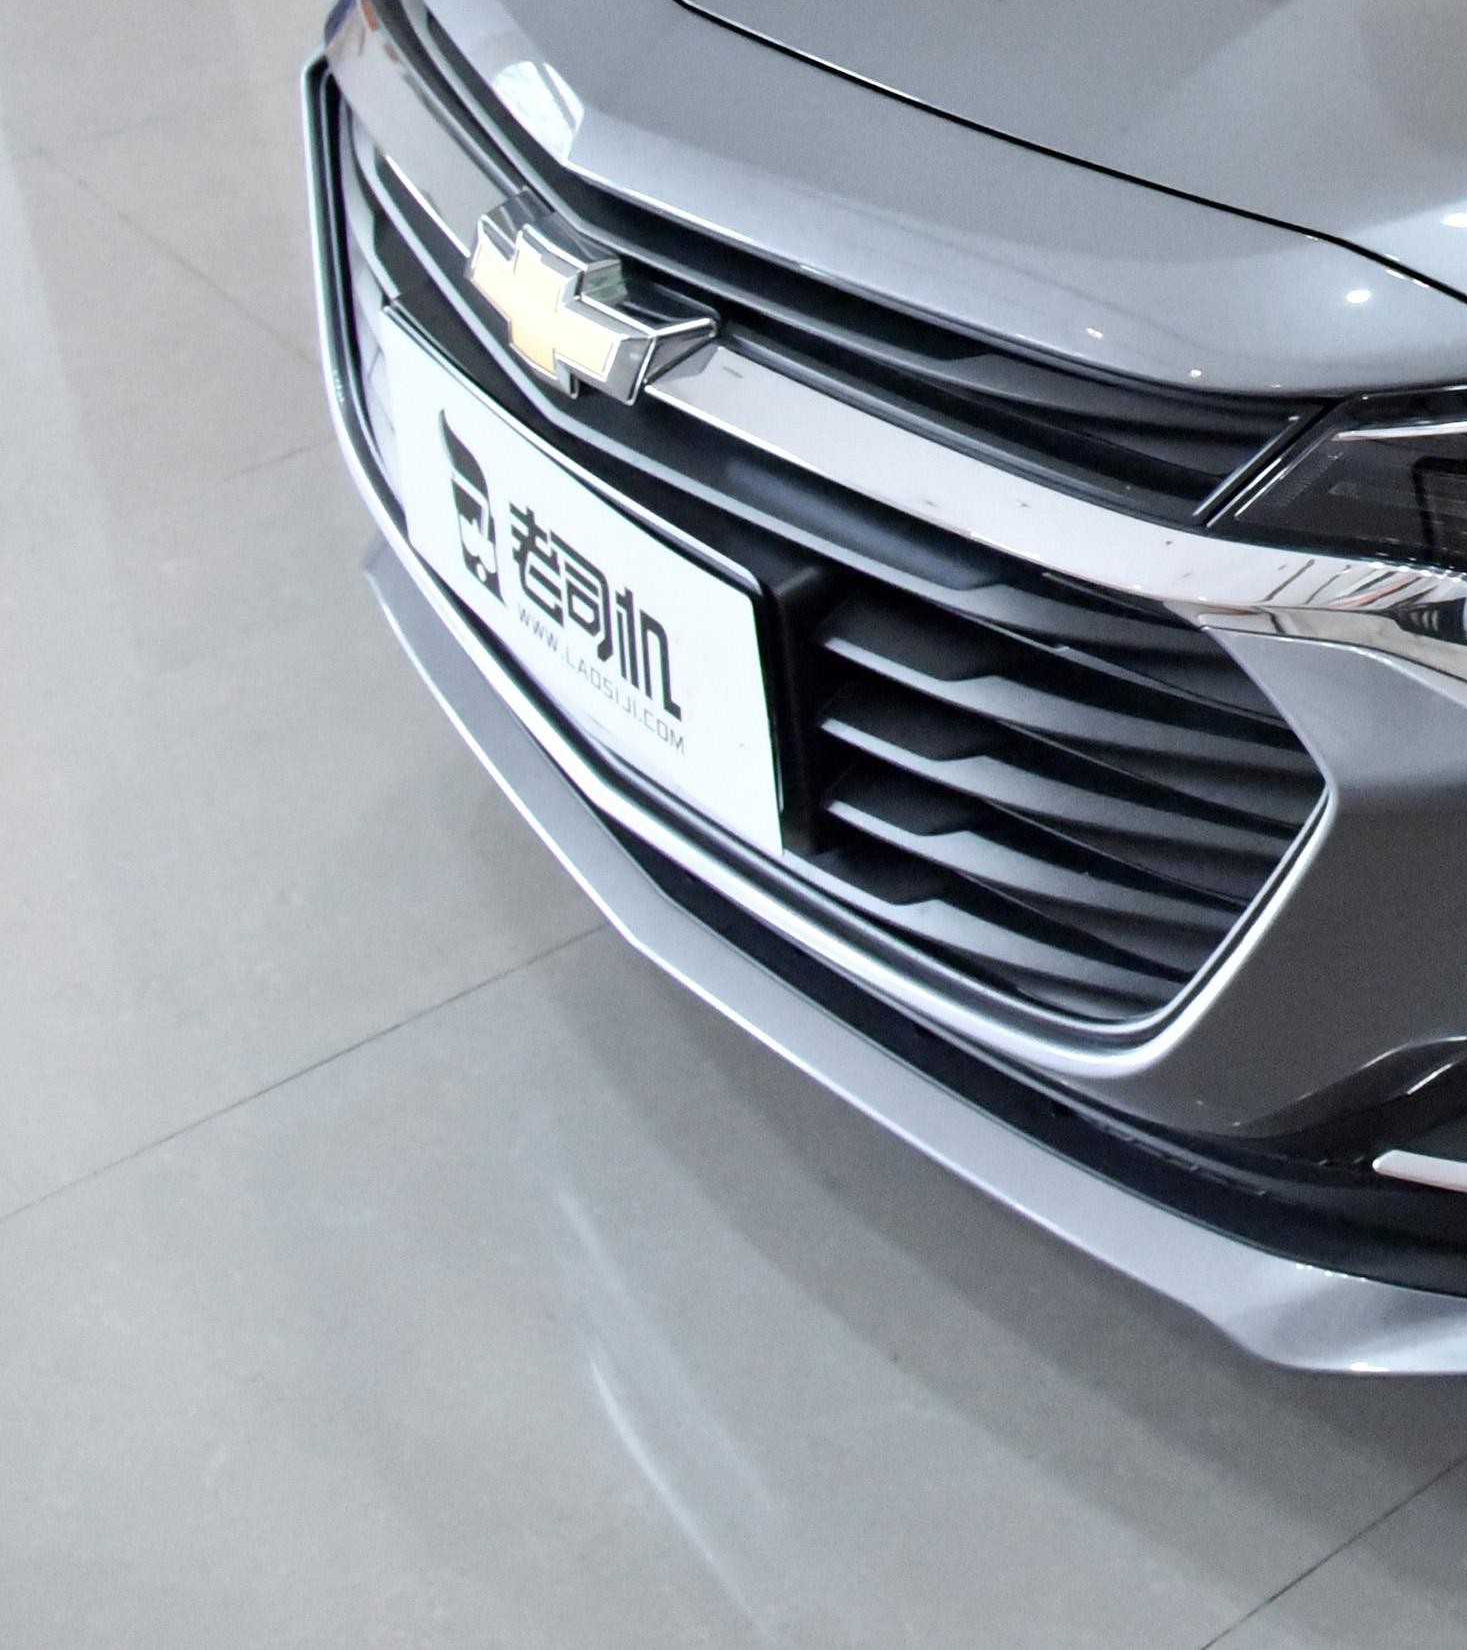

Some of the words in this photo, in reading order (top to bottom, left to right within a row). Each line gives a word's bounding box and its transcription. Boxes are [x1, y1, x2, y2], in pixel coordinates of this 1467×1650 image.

[509, 501, 682, 722] 老司机
[518, 604, 685, 755] WWW.LAOSIJI.COM
